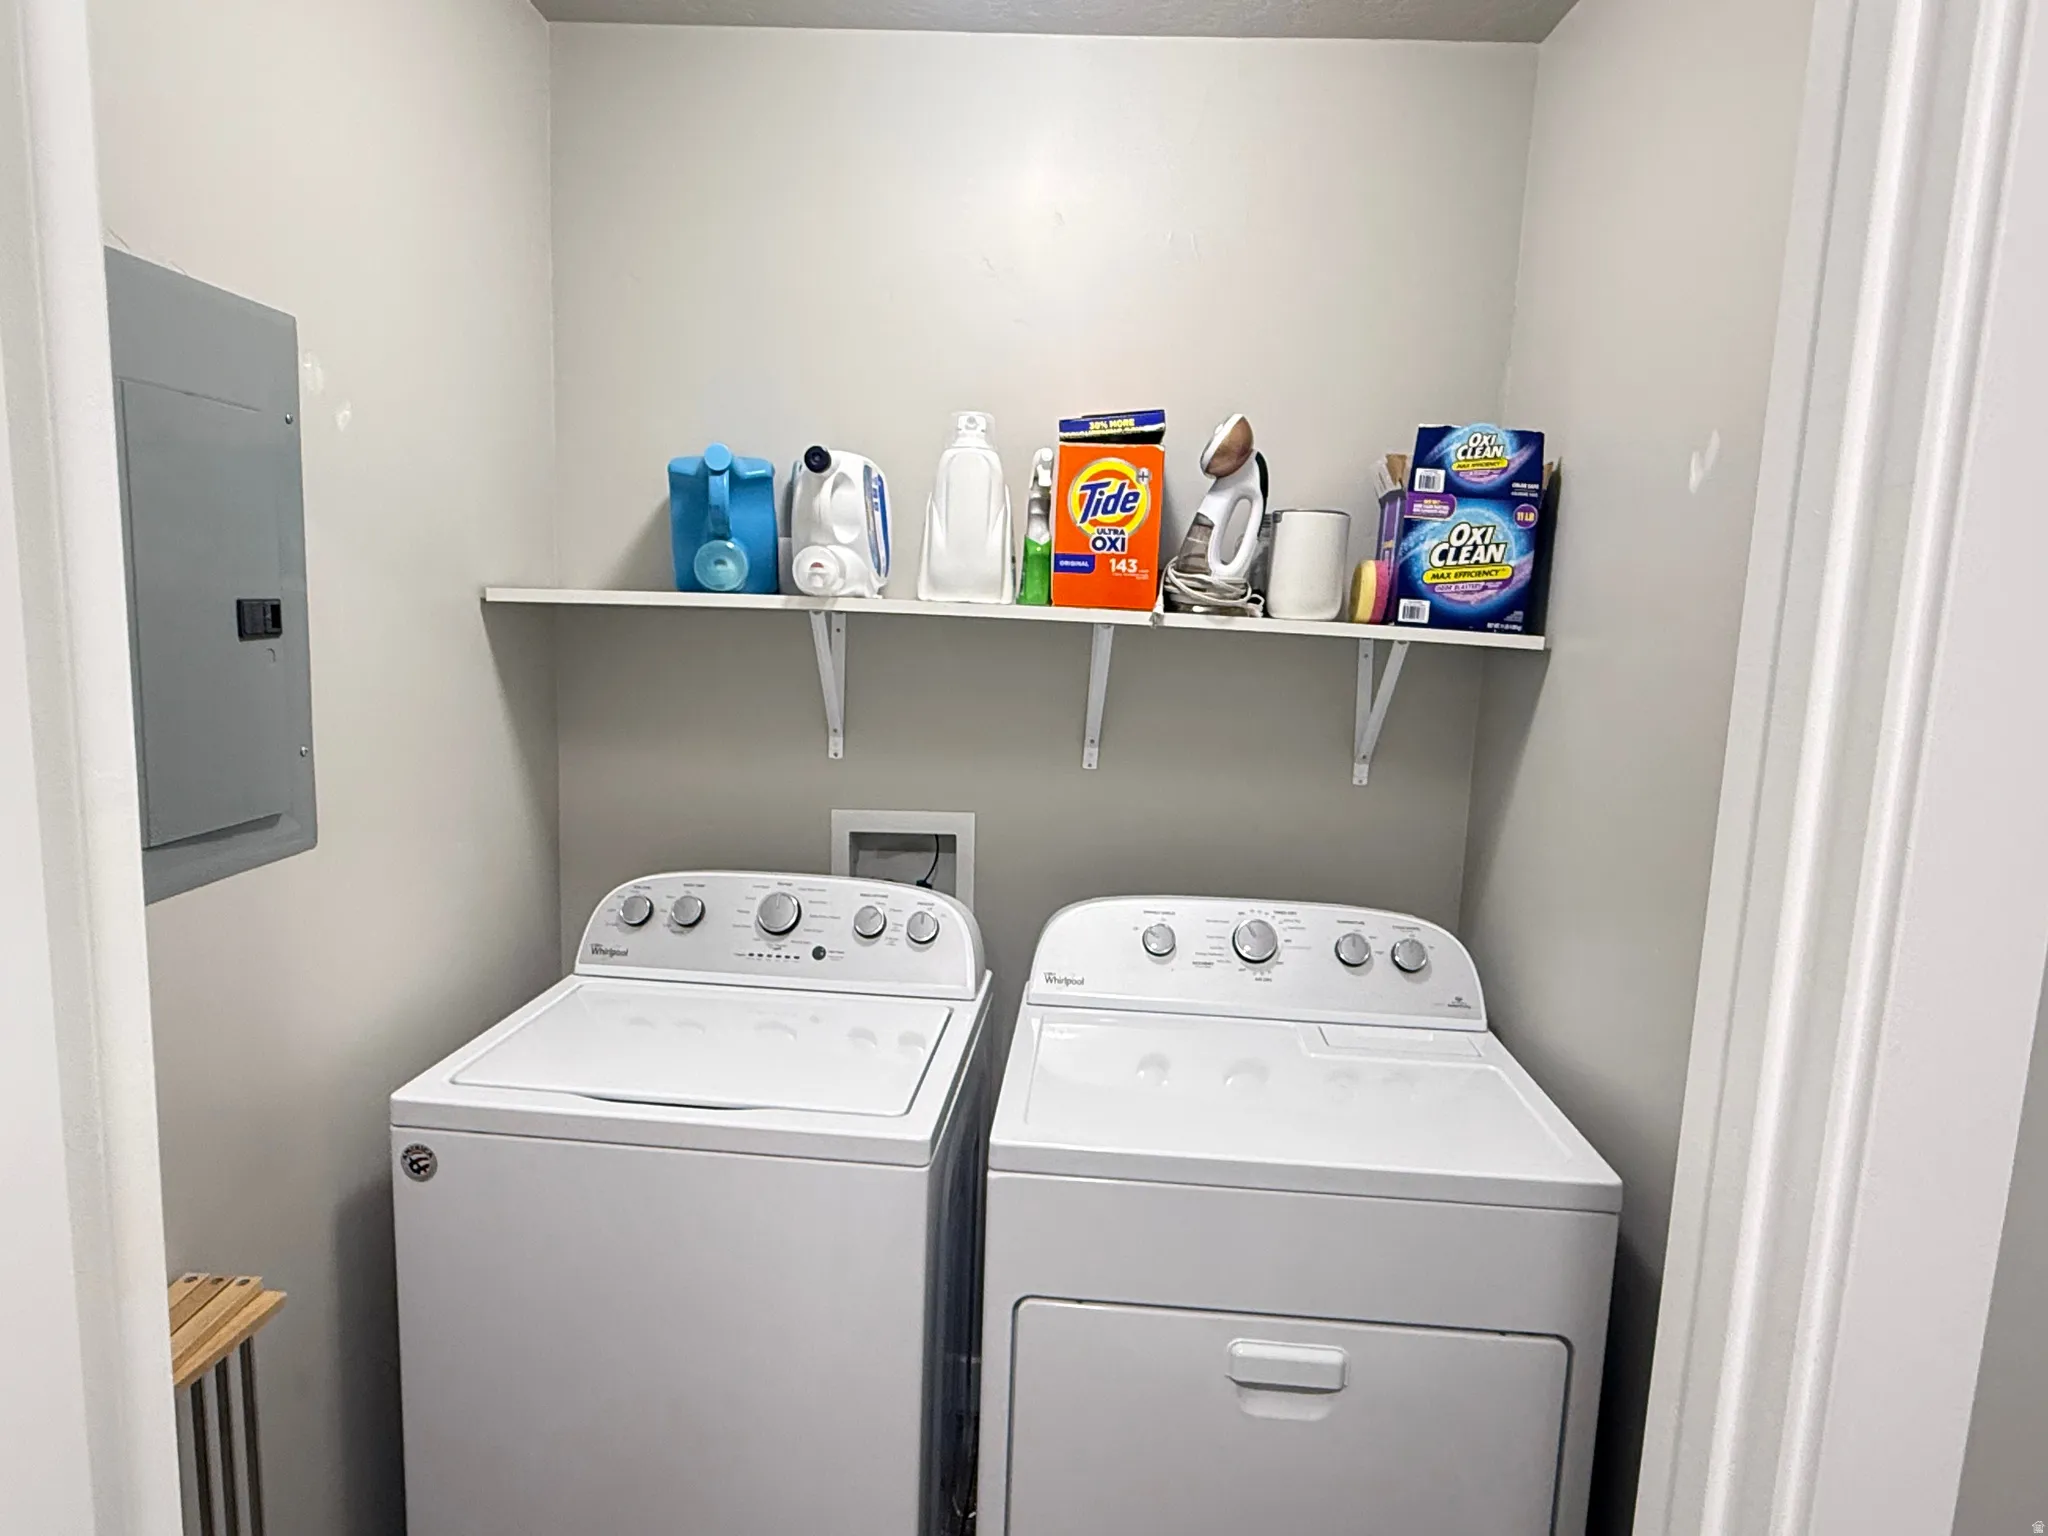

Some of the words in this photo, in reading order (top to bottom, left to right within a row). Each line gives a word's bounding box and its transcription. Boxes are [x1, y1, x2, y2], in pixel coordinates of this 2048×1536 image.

[1109, 418, 1135, 430] MORE
[1469, 432, 1498, 447] OXI
[1457, 445, 1504, 460] CLEAN
[1078, 480, 1141, 525] Tide
[1525, 511, 1535, 521] LB
[1096, 528, 1125, 536] ULTRA
[1450, 522, 1496, 546] OXI
[1092, 536, 1126, 552] OXI
[1430, 542, 1507, 568] CLEAN
[1109, 558, 1138, 573] 143
[1431, 572, 1451, 580] MAX
[1454, 569, 1499, 579] EFFICIENCY
[591, 947, 628, 957] Whirlpool
[1044, 975, 1084, 986] Whirlpool
